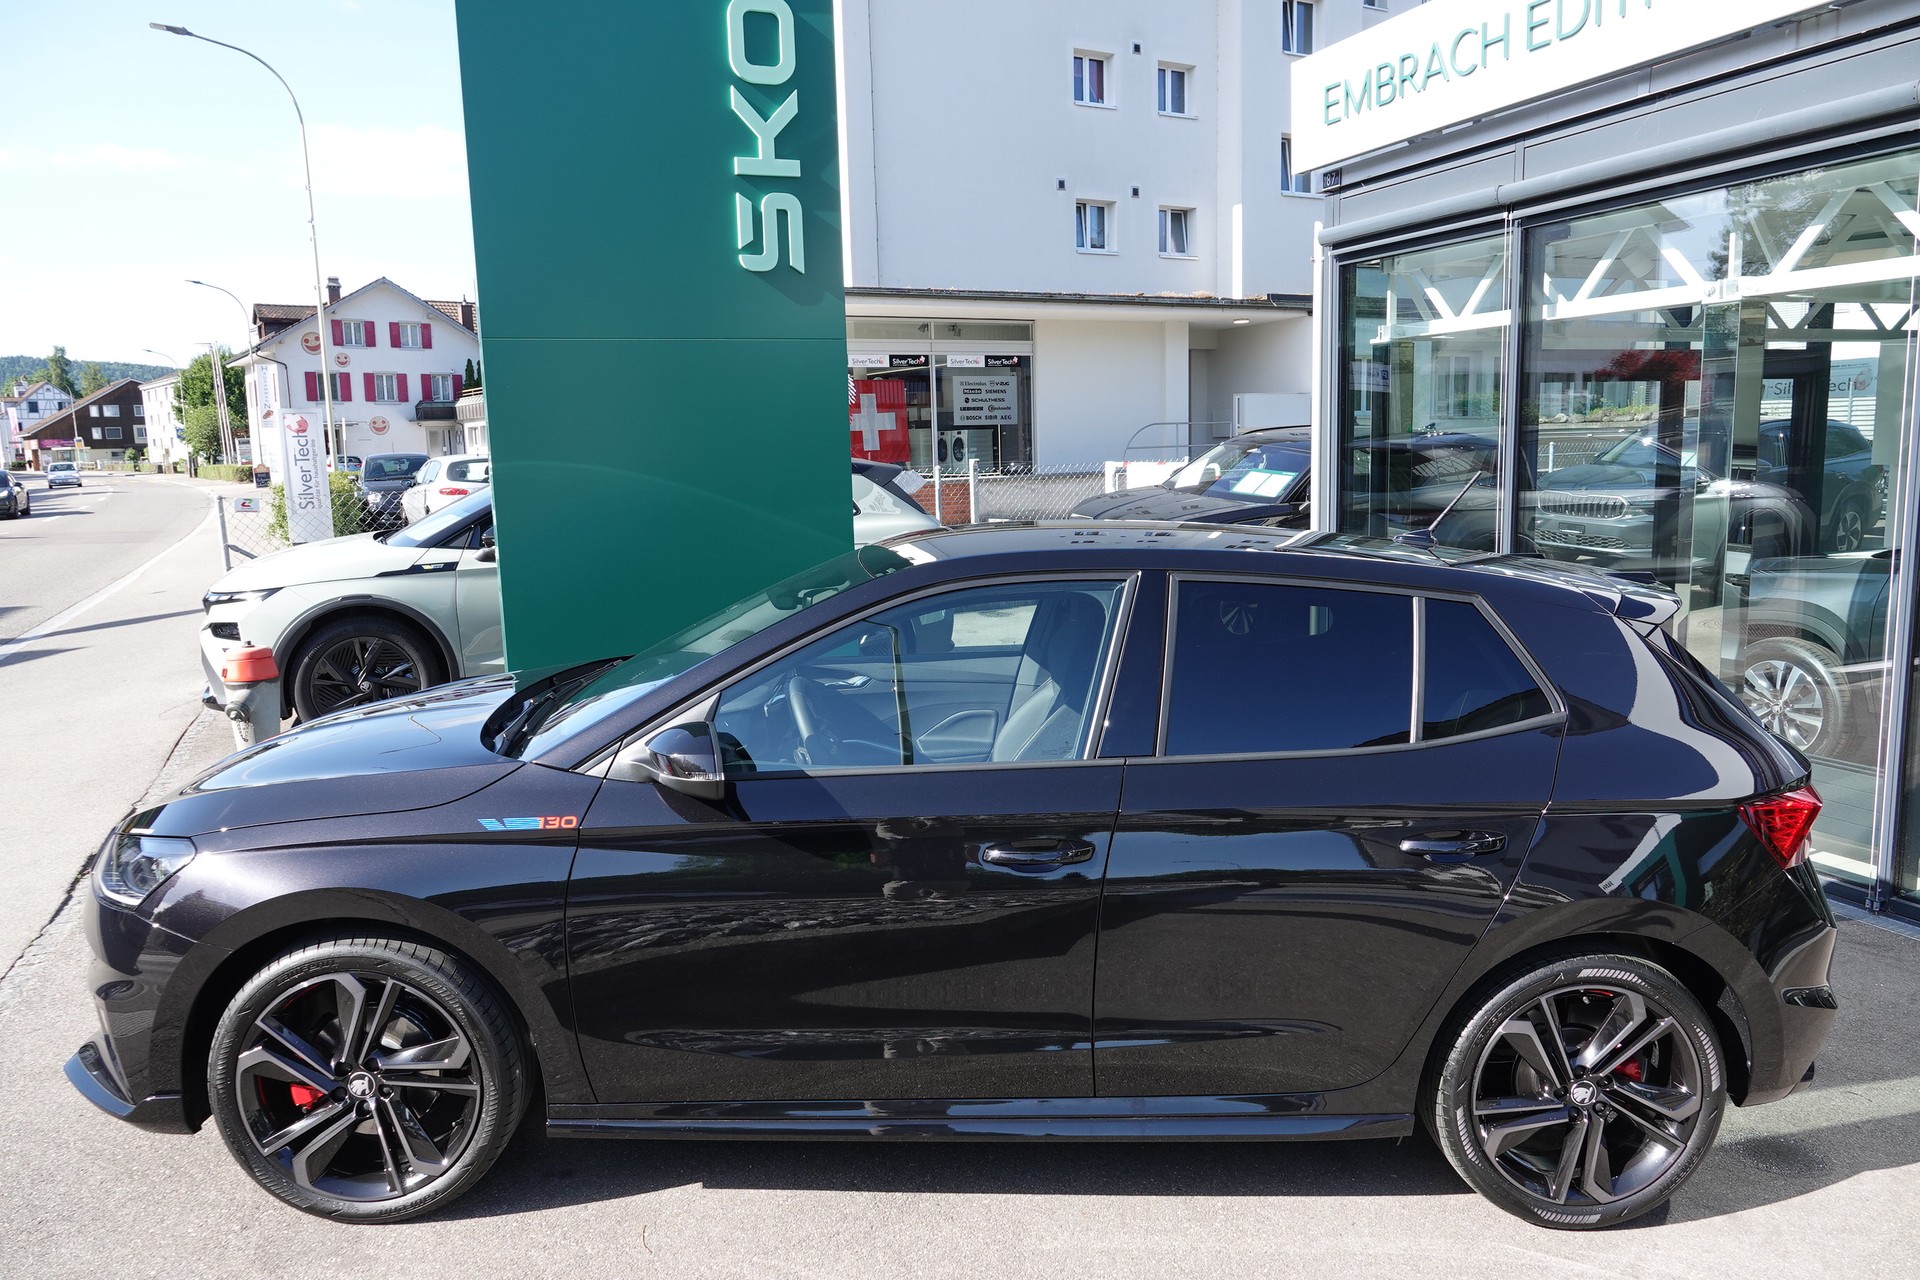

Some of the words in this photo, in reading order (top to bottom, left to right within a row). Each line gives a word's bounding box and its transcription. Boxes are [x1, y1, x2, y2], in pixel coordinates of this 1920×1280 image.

[1324, 12, 1511, 126] EMBRACH
[1325, 172, 1337, 187] 87
[537, 815, 578, 829] 130
